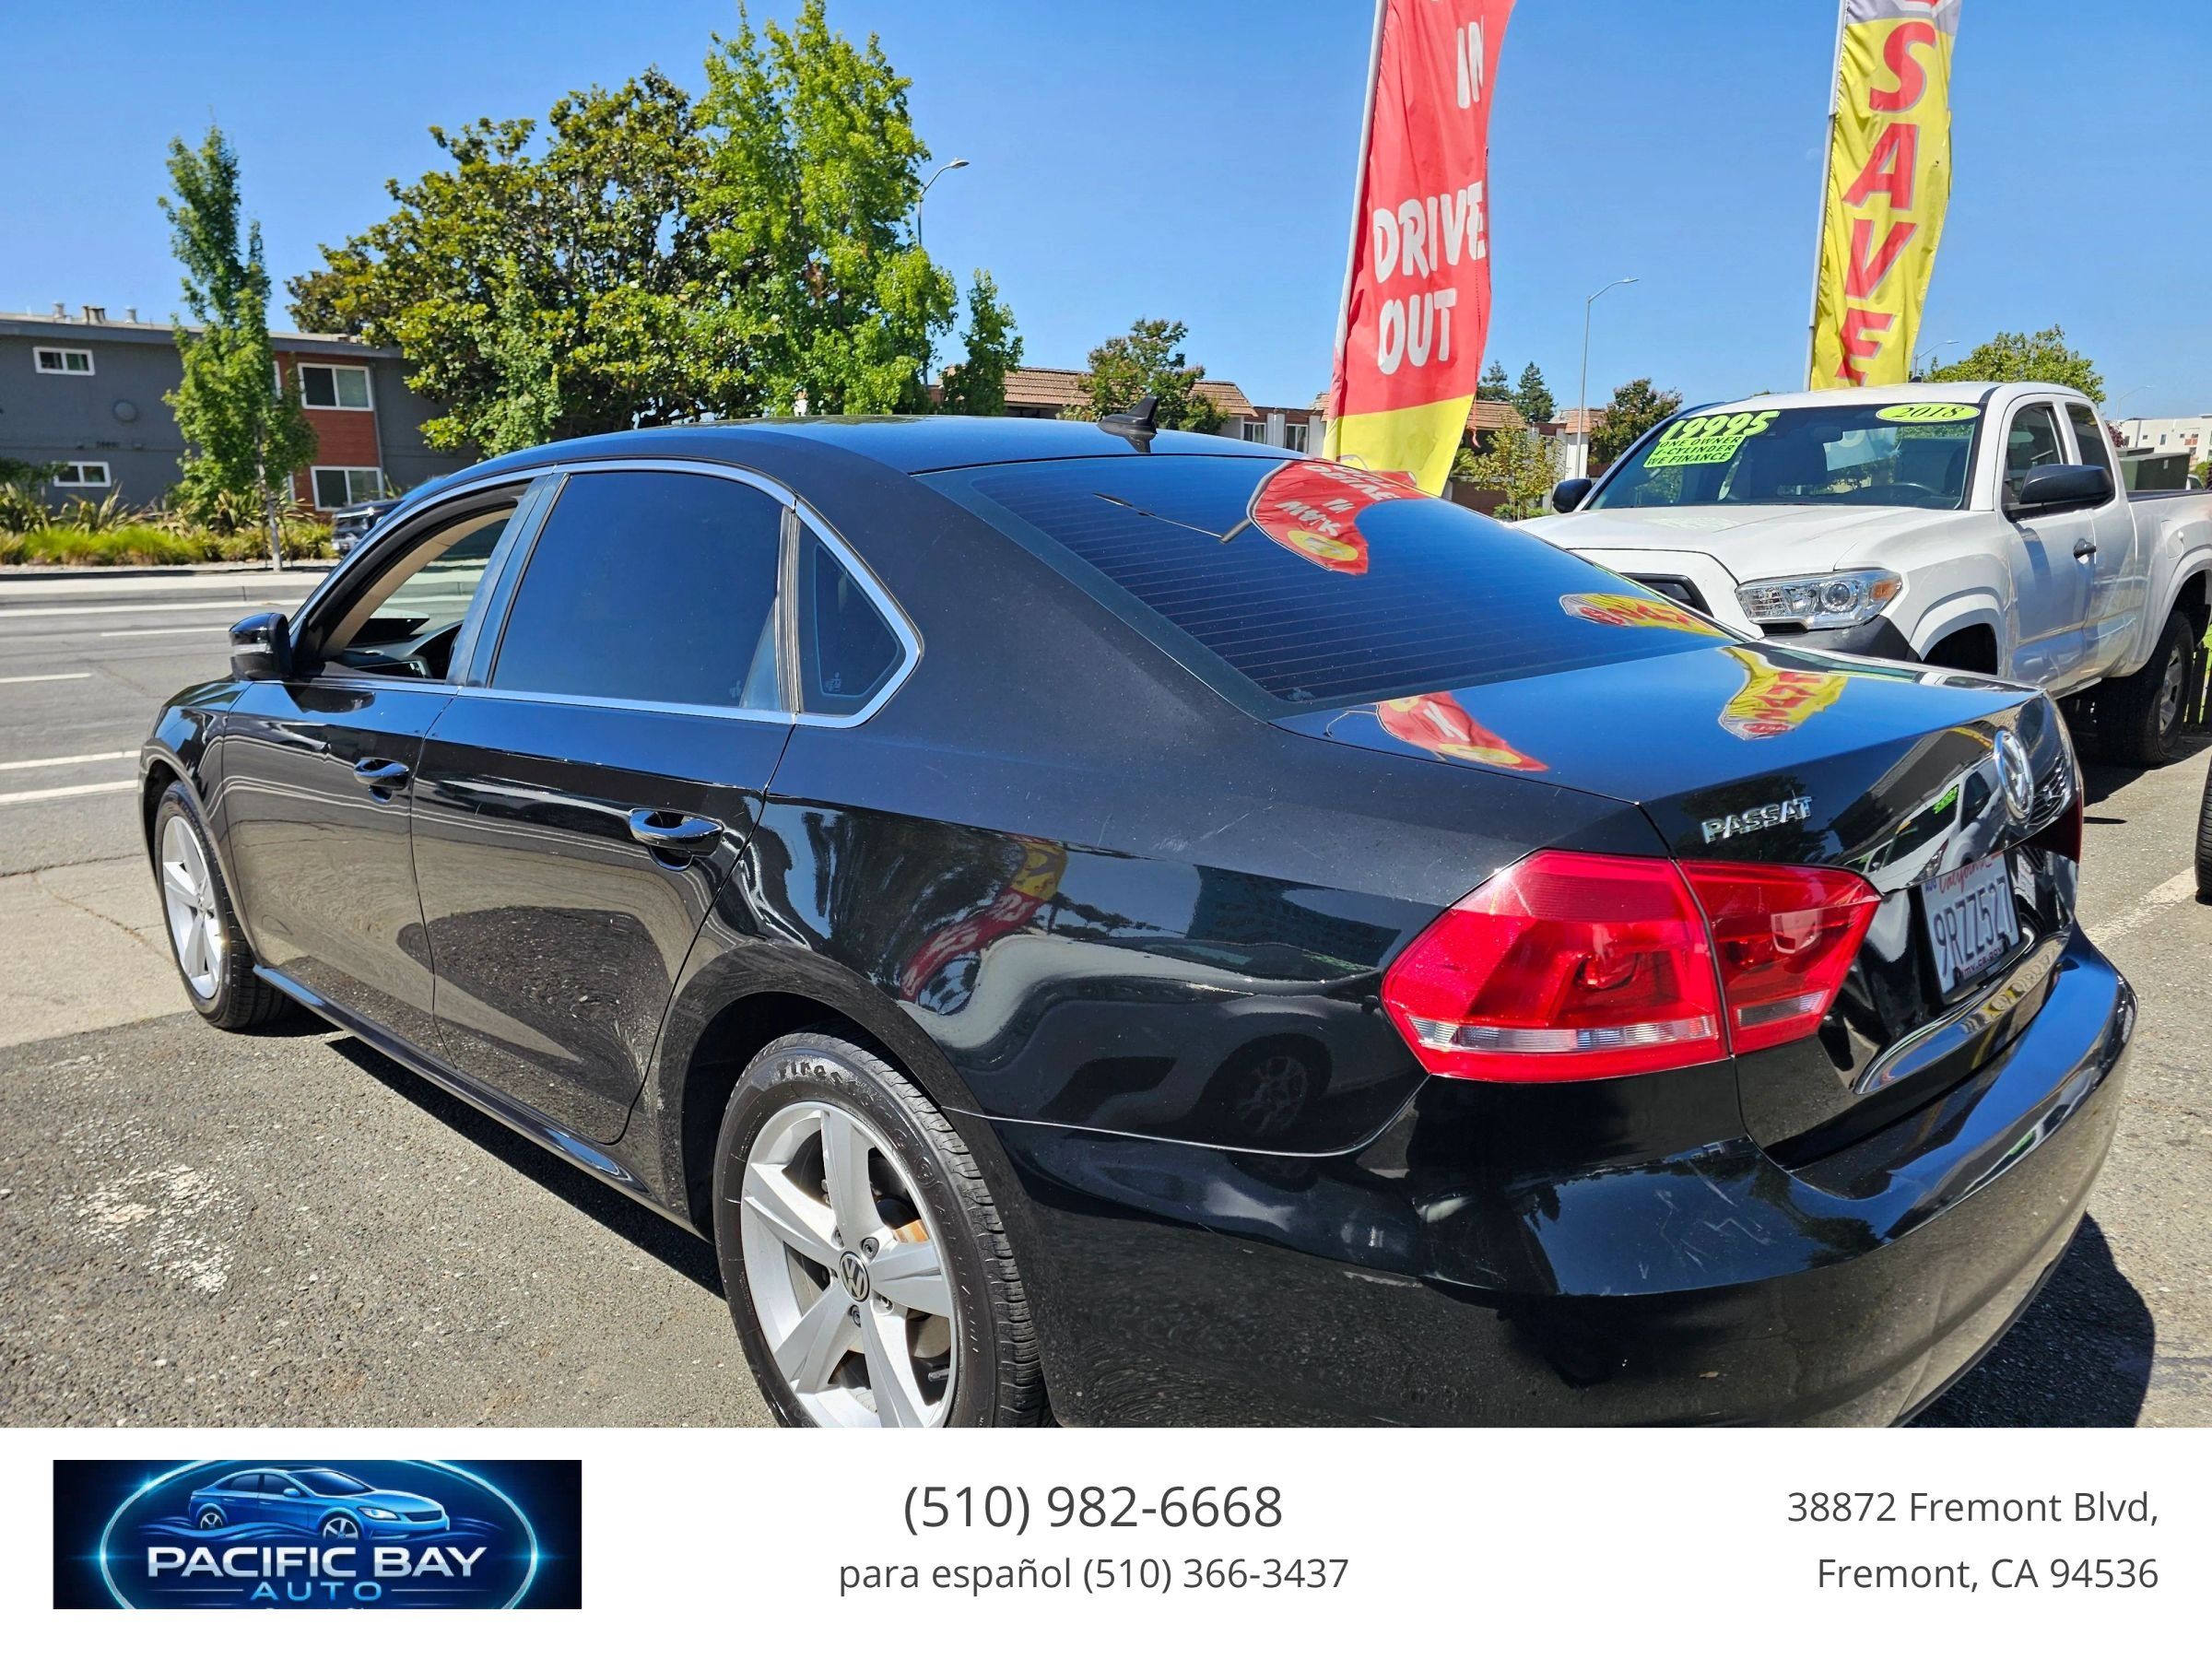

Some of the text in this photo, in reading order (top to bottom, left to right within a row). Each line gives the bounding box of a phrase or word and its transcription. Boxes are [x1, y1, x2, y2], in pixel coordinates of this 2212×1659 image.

[1457, 14, 1484, 109] IN
[1834, 21, 1936, 387] SAVE
[1372, 180, 1487, 284] DRIVE
[1377, 287, 1457, 375] OUT
[1659, 411, 1781, 442] 19995
[1892, 406, 1965, 418] 2018
[1646, 452, 1730, 466] WE FINANCE
[1659, 436, 1742, 448] ONE OWNER
[1701, 795, 1813, 844] PASSAT
[1934, 875, 2013, 978] 9RZZ527
[1961, 947, 2003, 978] mv.ca.gov
